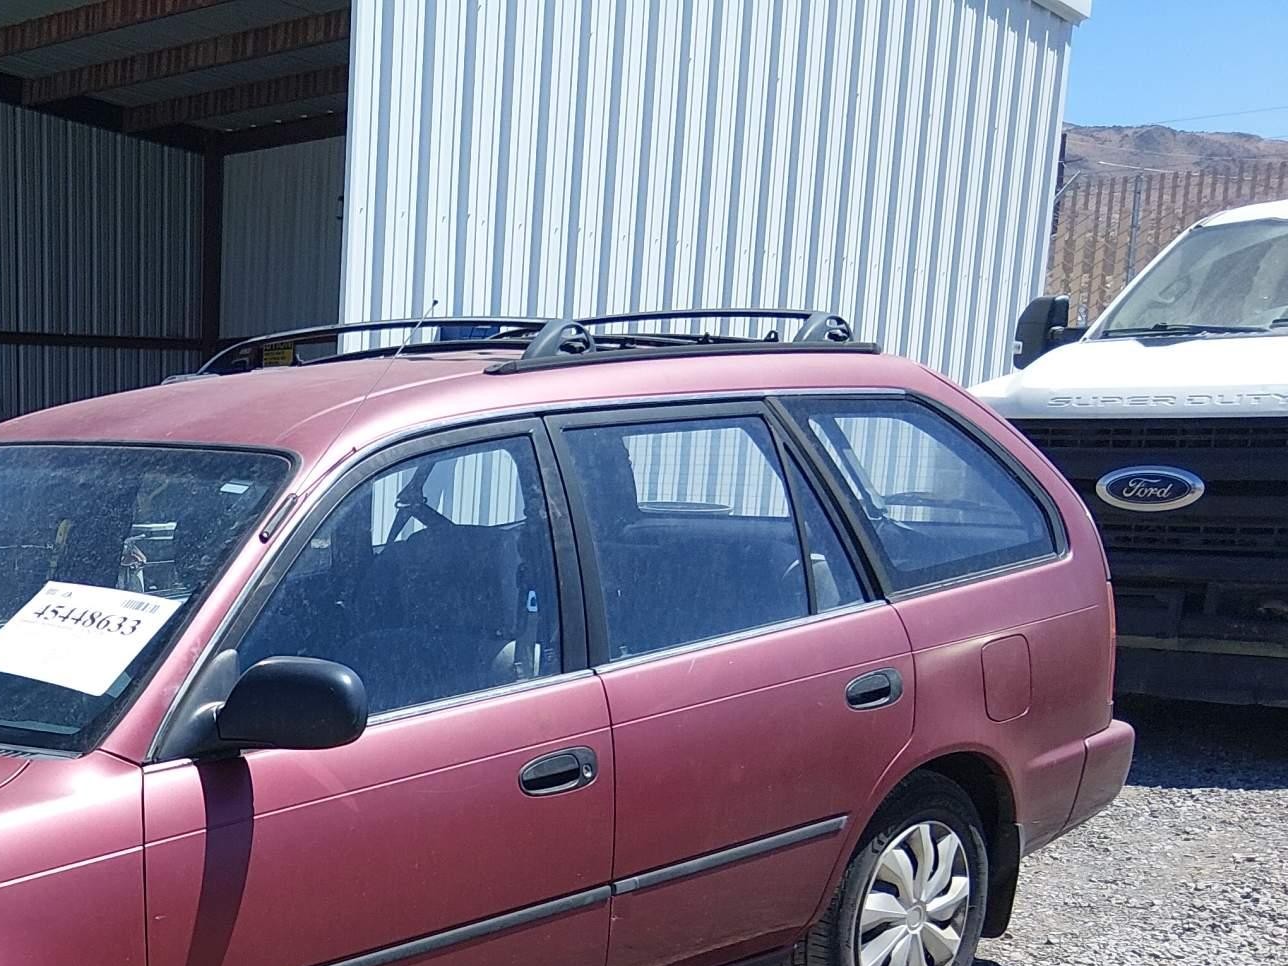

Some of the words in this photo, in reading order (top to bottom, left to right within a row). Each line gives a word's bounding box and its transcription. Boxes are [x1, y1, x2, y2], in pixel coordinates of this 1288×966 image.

[1047, 394, 1176, 408] SUPER
[1183, 392, 1288, 407] DUTY
[1122, 476, 1174, 498] Ford
[33, 603, 142, 636] 45448633
